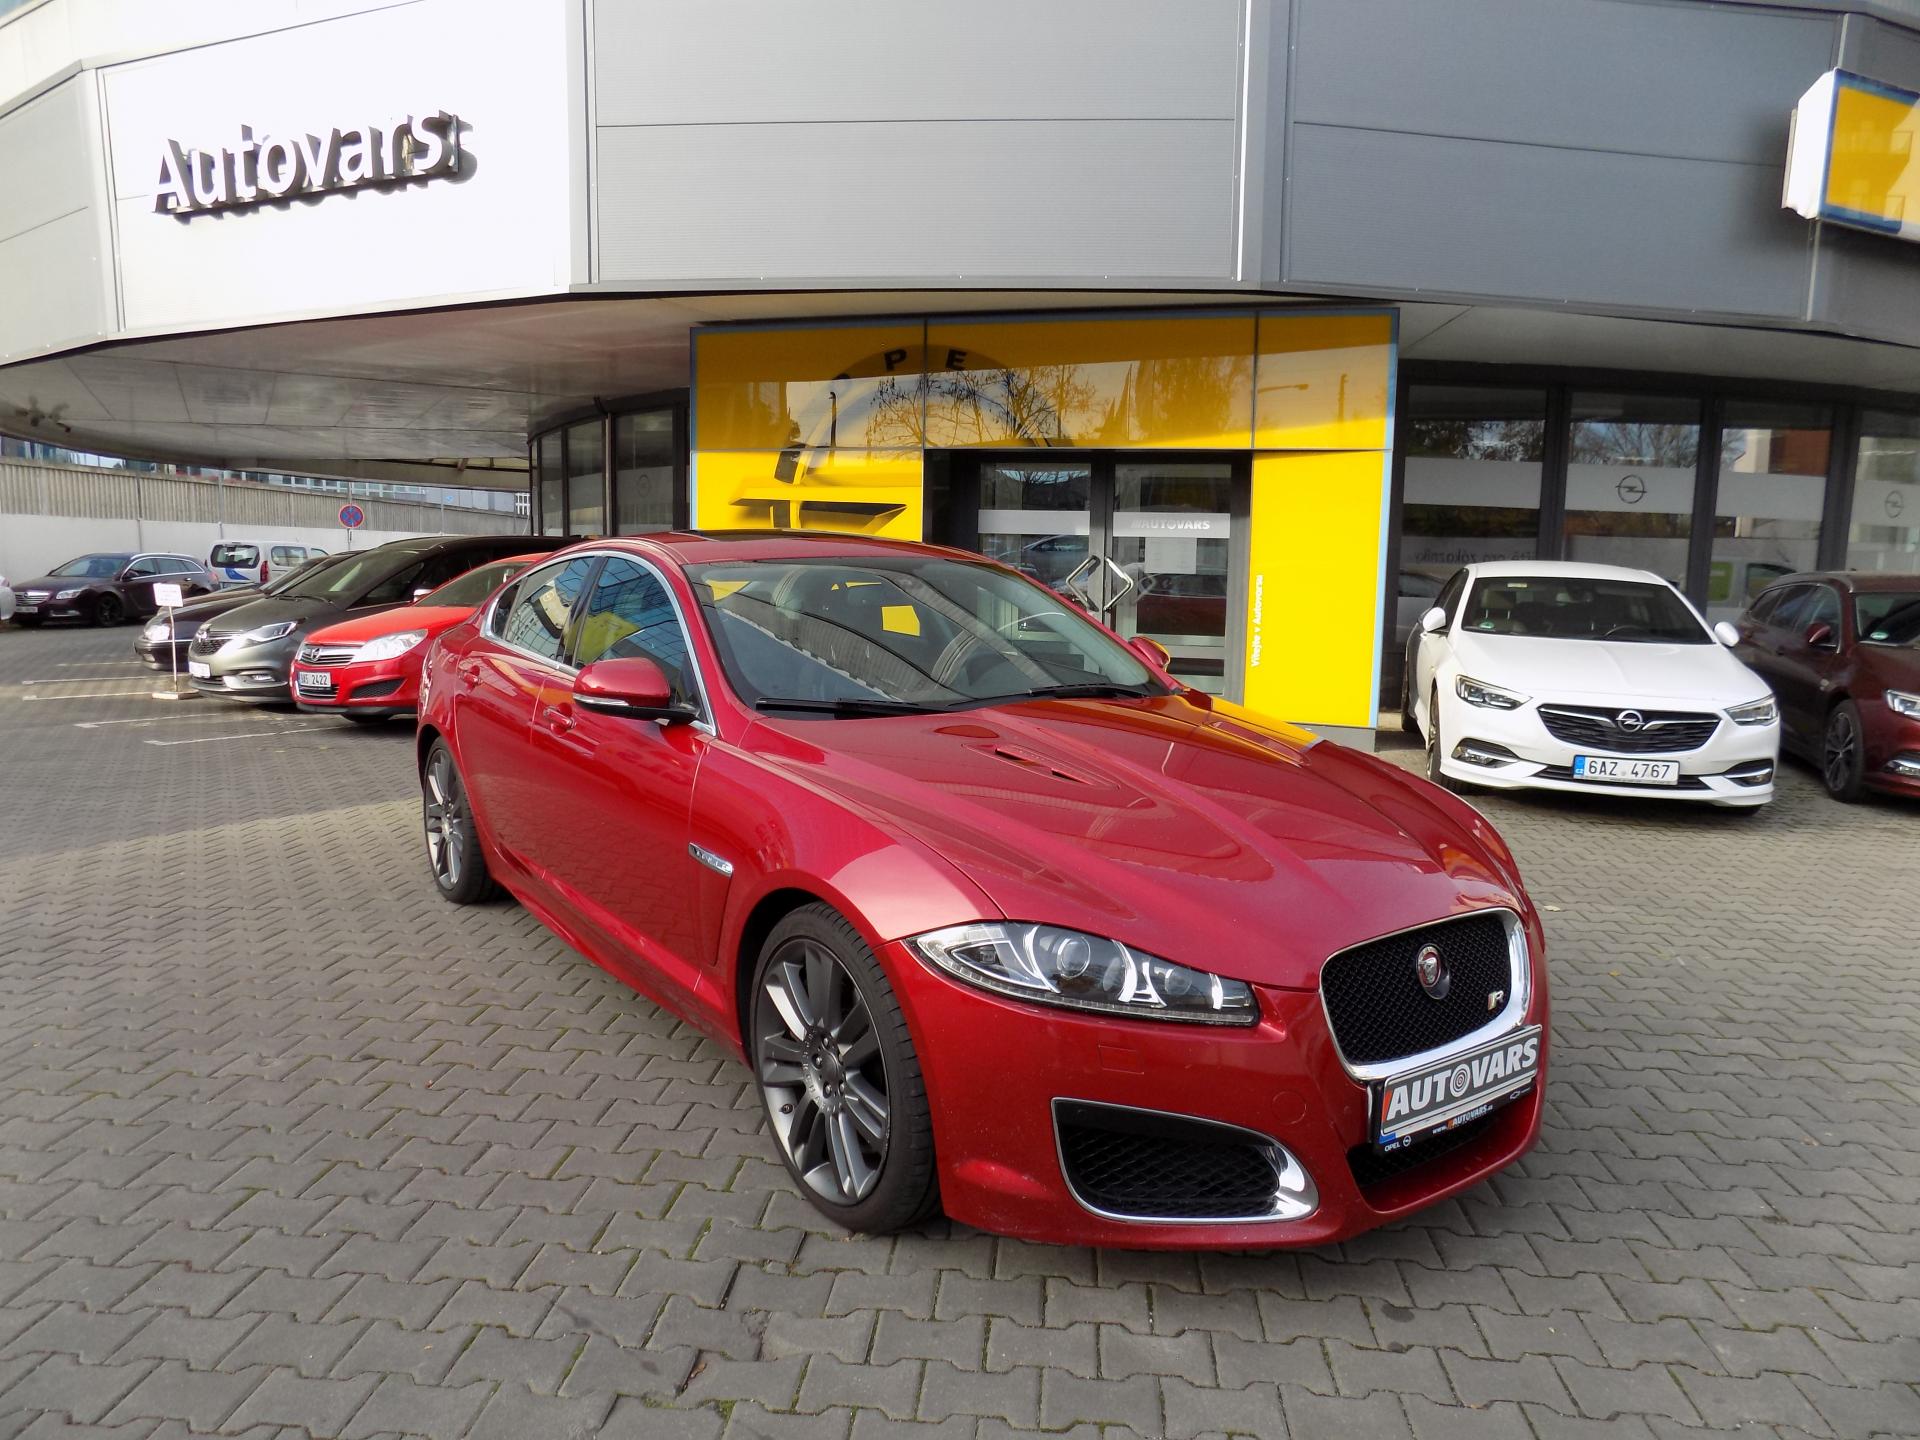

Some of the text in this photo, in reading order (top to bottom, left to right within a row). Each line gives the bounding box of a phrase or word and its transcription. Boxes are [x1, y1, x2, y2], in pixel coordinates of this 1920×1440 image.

[152, 110, 458, 216] Autovars
[1141, 519, 1210, 530] AUTOVARS
[312, 675, 327, 685] 2422
[1588, 760, 1670, 779] 6AZ 4767
[1386, 1037, 1538, 1121] AUTOVARS
[1385, 1141, 1401, 1152] OPEL
